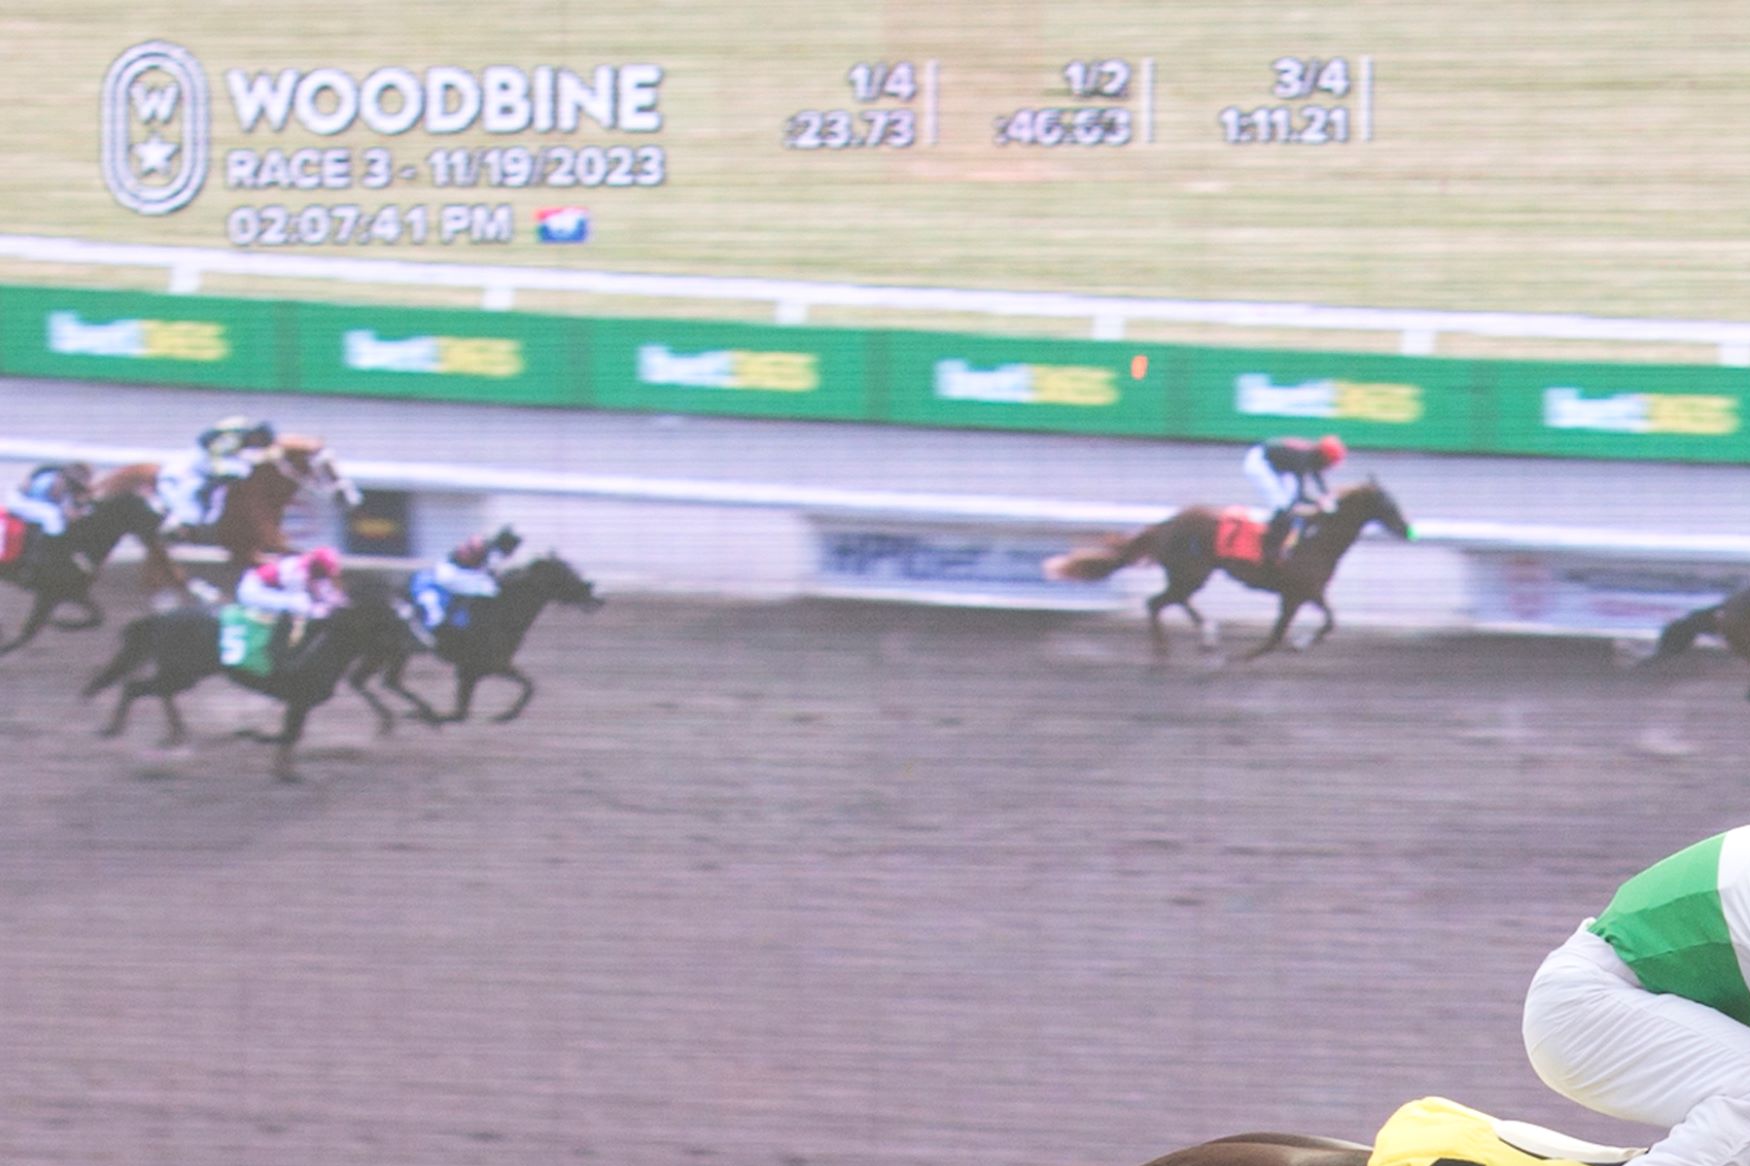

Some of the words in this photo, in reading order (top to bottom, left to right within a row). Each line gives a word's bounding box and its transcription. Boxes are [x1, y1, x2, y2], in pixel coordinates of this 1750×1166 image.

[847, 61, 917, 101] 1/4
[1063, 59, 1132, 97] 1/2
[1271, 56, 1350, 98] 3/4
[226, 65, 664, 136] WOODBINE
[1219, 106, 1350, 143] 1:11.21
[226, 147, 351, 189] RACE
[362, 146, 393, 189] 3
[428, 145, 665, 187] 11/19/2023
[226, 204, 428, 246] 02:07:41
[440, 203, 514, 243] PM
[220, 625, 247, 667] 5
